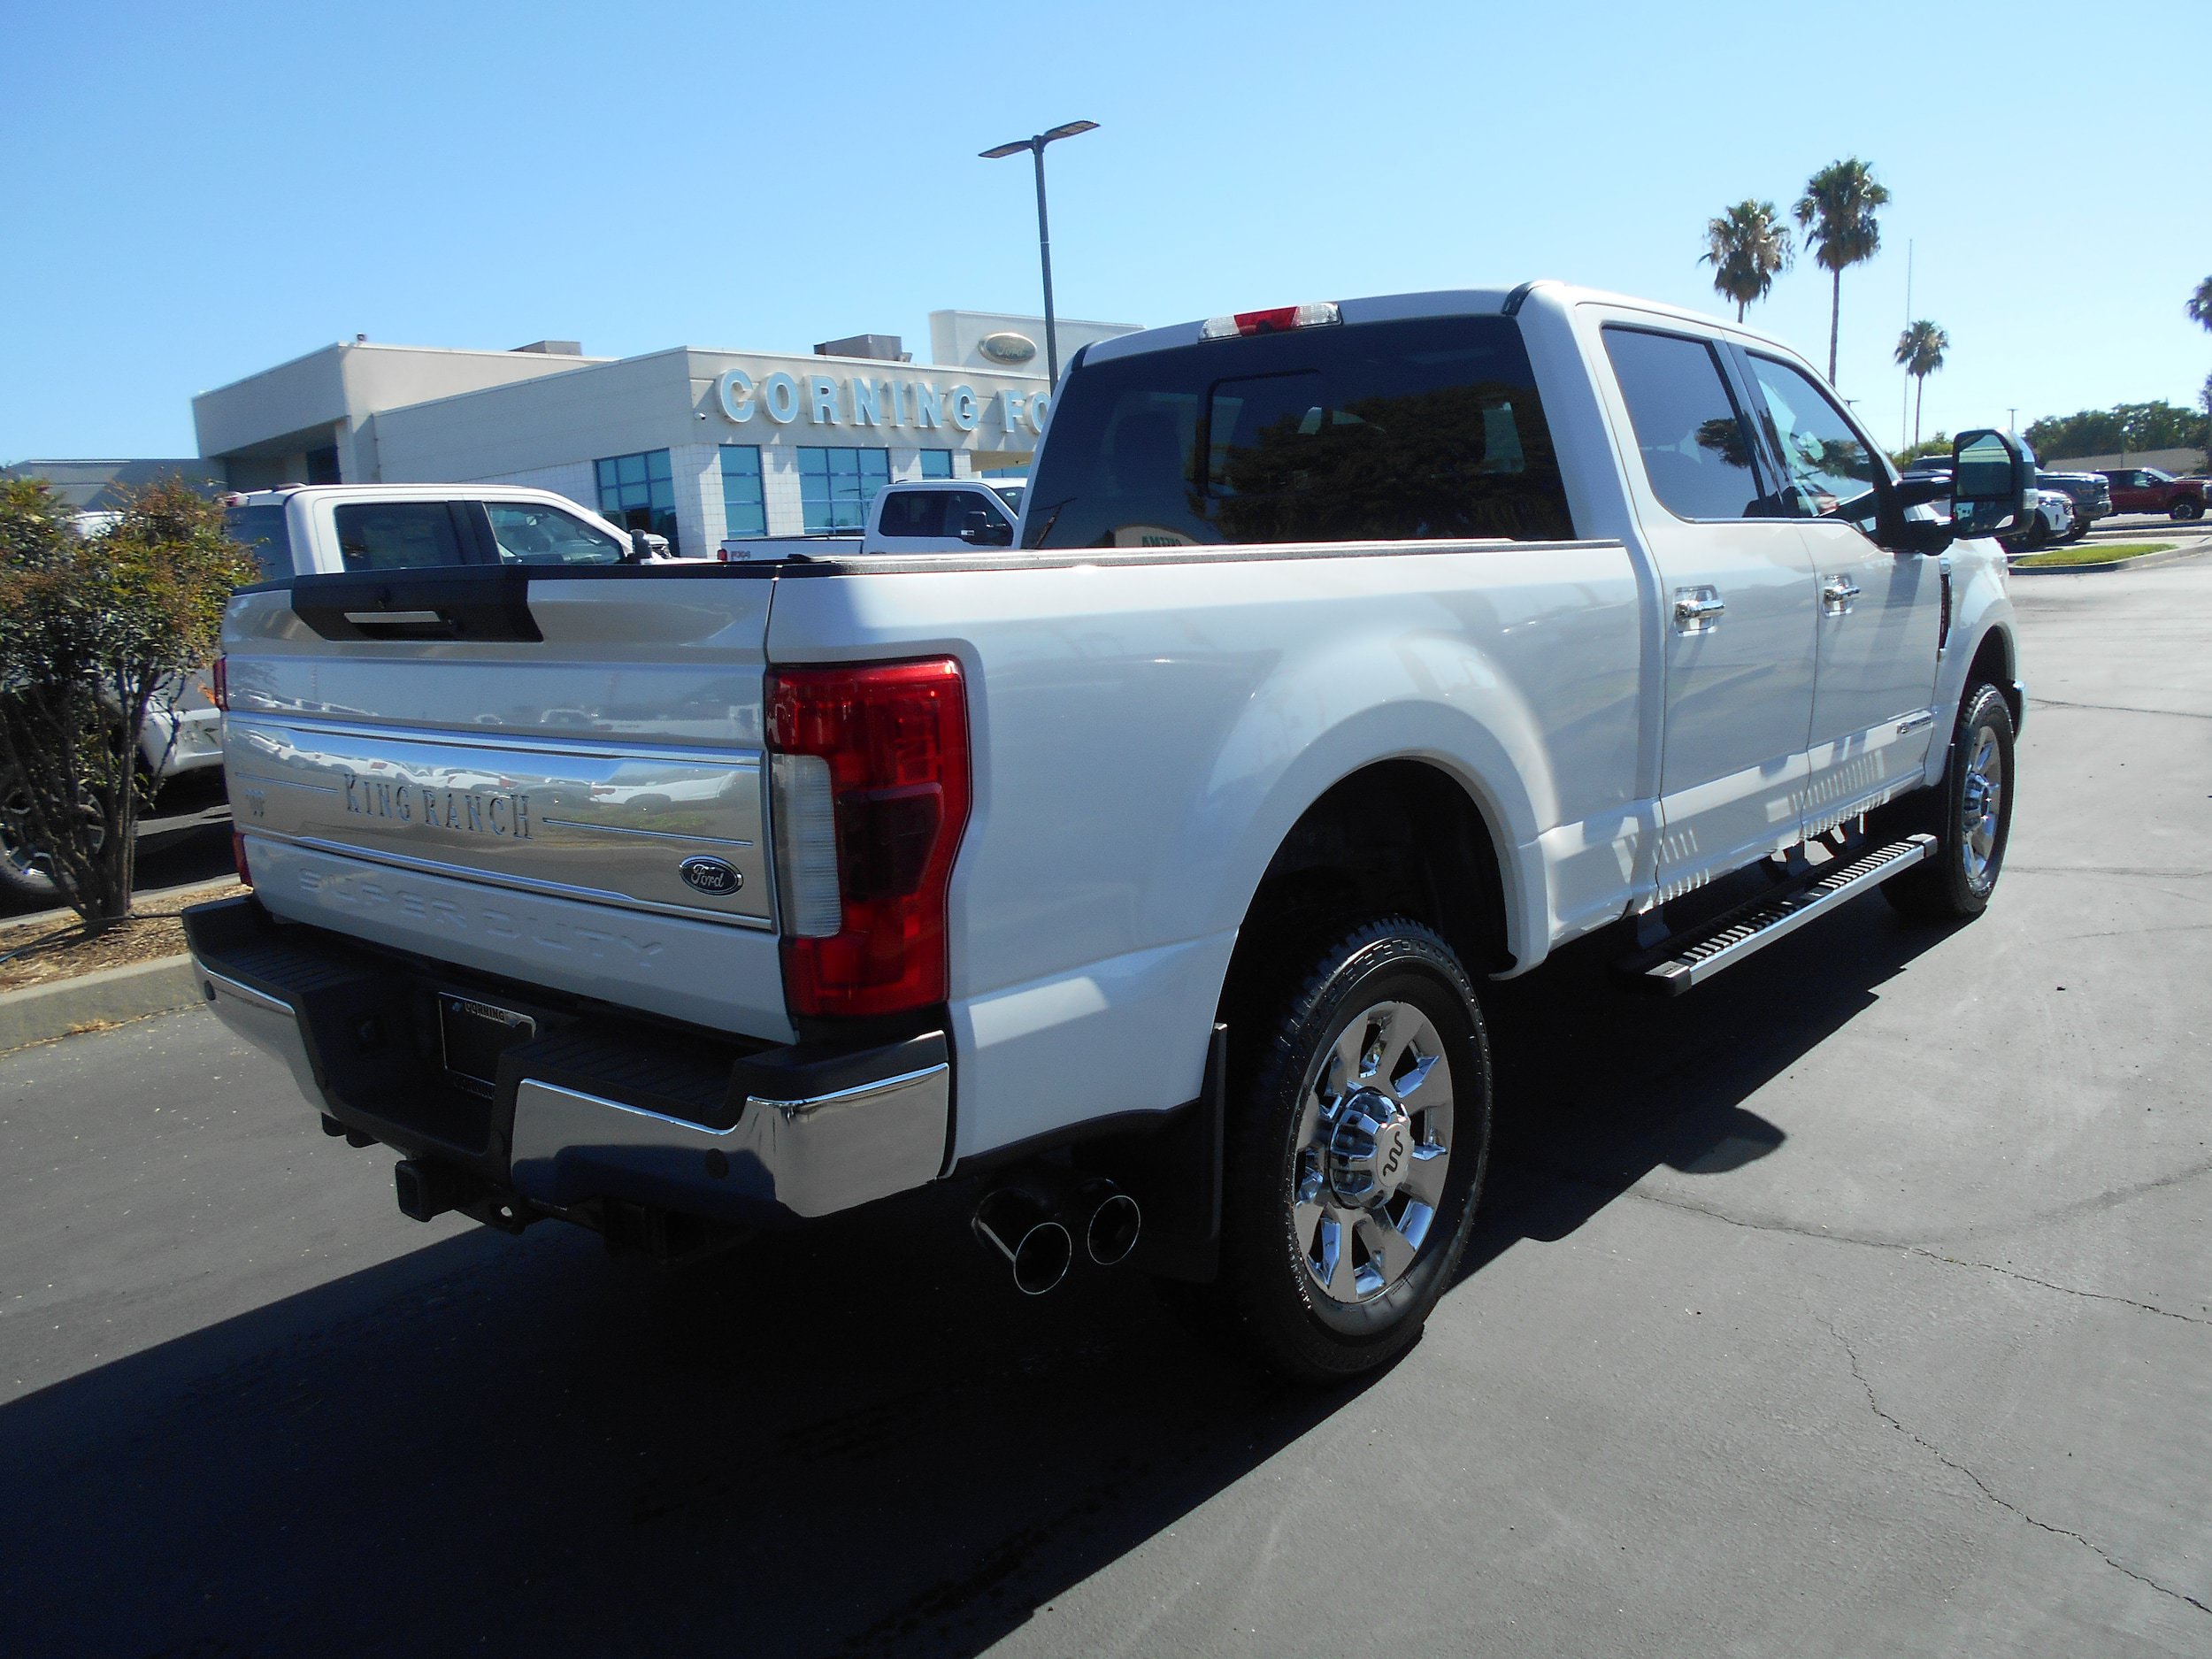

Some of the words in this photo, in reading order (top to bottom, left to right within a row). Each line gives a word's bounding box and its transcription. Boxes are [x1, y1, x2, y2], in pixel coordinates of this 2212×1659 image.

[717, 368, 978, 432] CORNING
[1001, 389, 1052, 434] FO
[343, 773, 411, 822] KING
[422, 788, 534, 840] RANCH
[691, 864, 726, 887] Ford
[299, 867, 469, 929] SUPER
[483, 908, 664, 967] DUTY
[465, 1002, 506, 1021] CORNING
